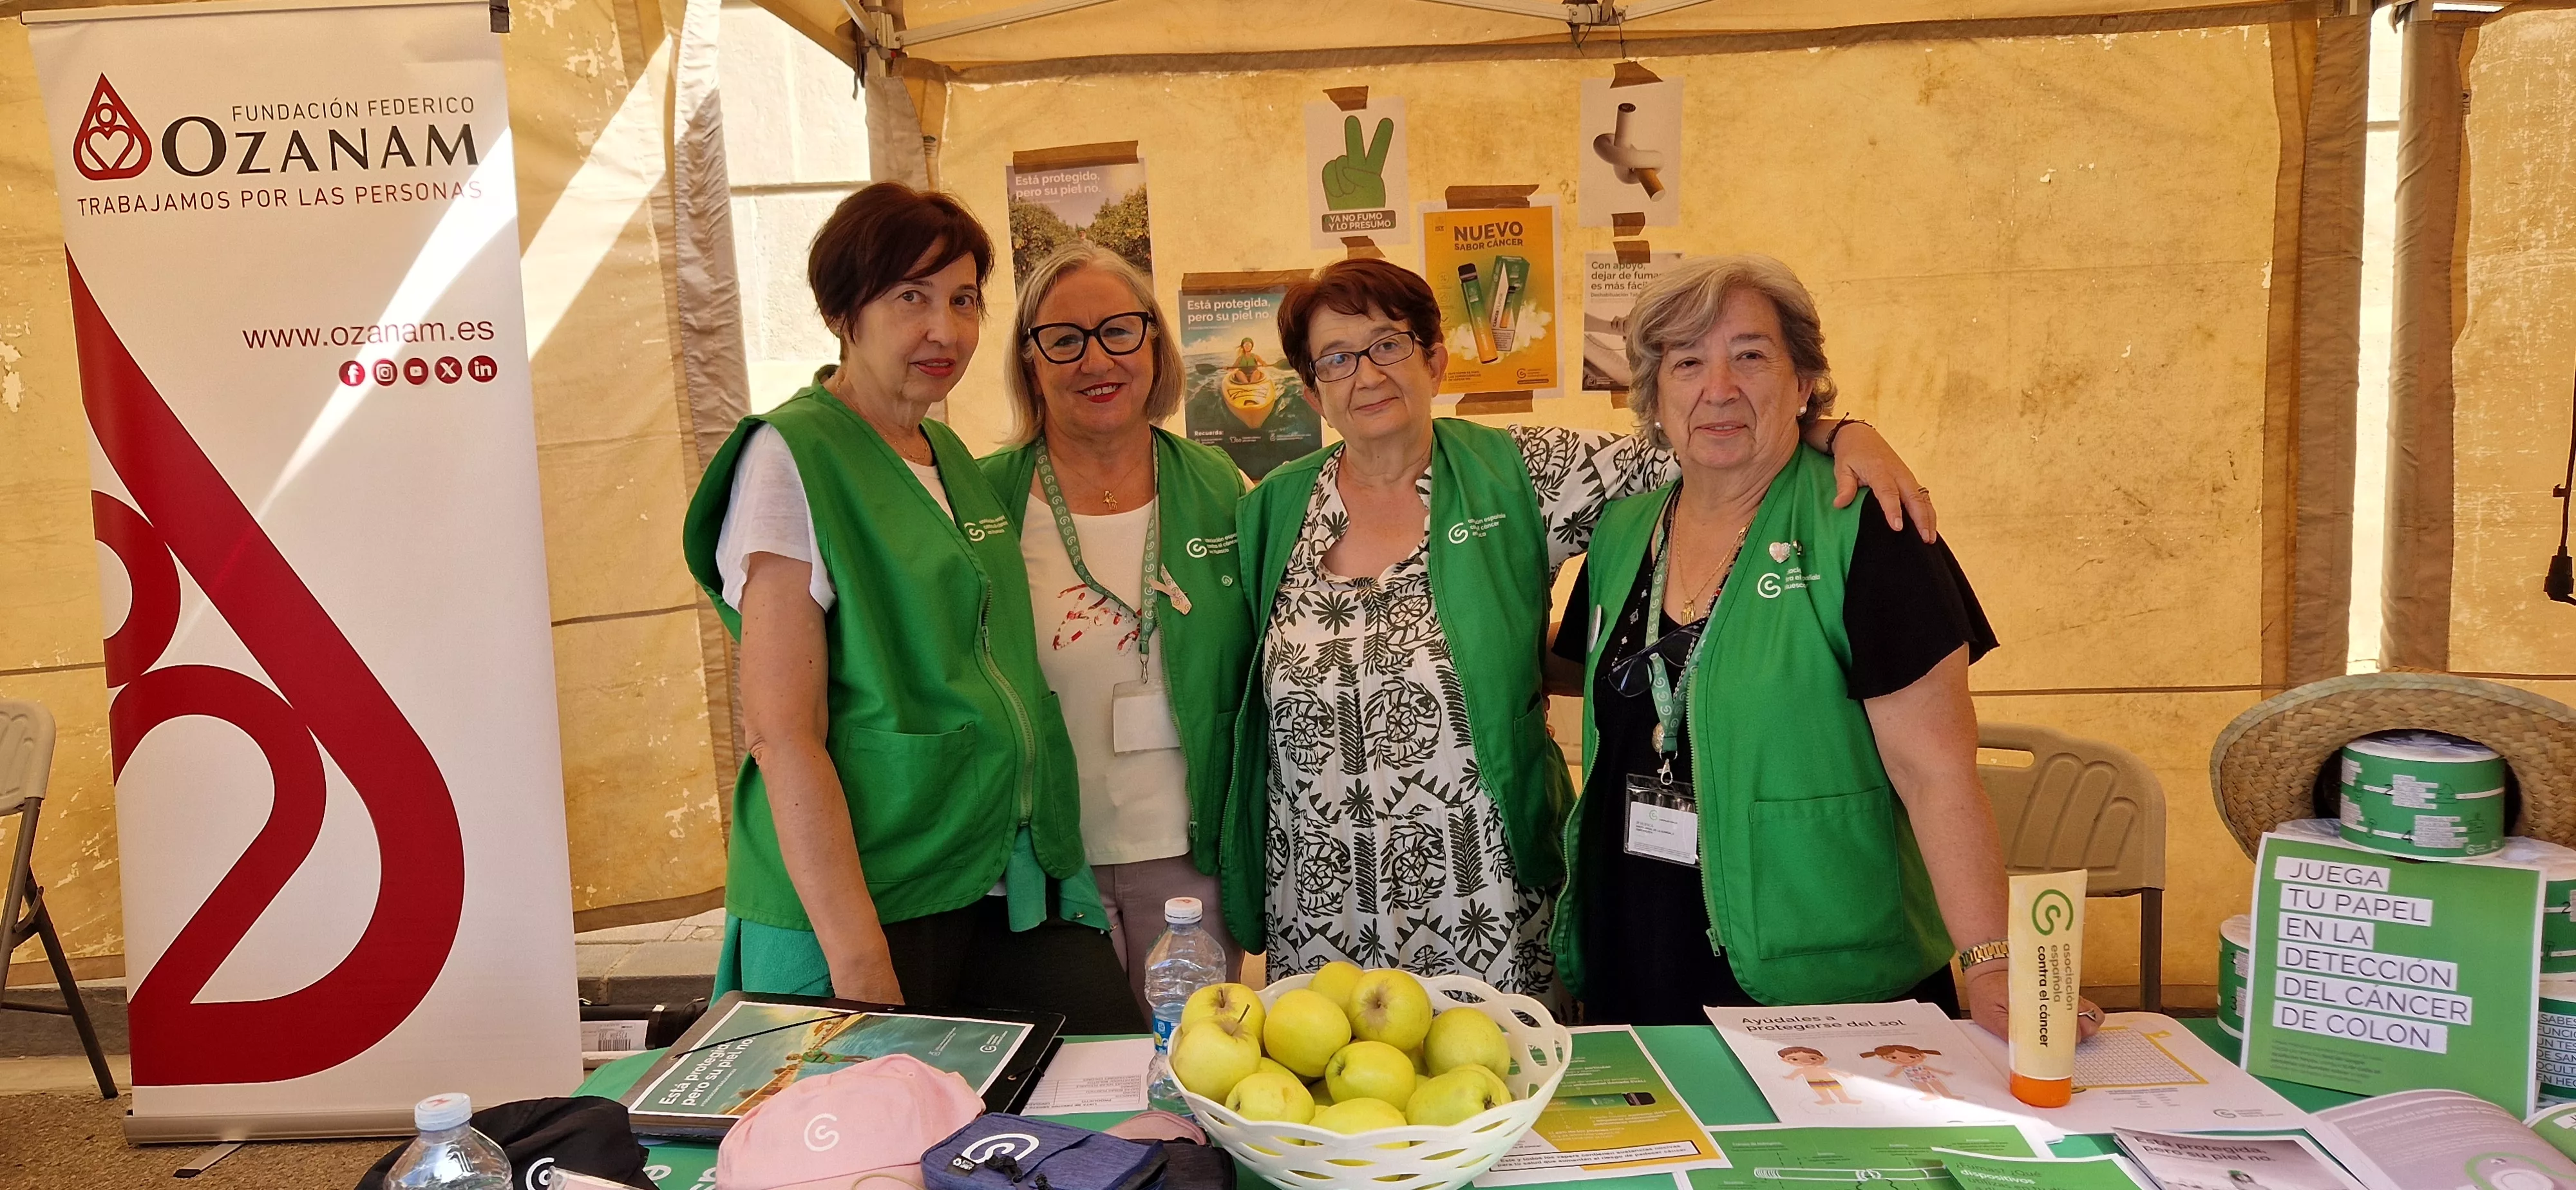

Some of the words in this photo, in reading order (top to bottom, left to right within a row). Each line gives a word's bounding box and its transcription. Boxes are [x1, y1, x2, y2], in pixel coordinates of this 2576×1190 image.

[232, 97, 359, 122] FUNDACIÓN
[368, 96, 475, 117] FEDERICO
[162, 116, 479, 177] OZANAM
[1016, 175, 1039, 185] Está
[78, 191, 231, 216] TRABAJAMOS
[241, 190, 287, 208] POR
[299, 187, 345, 206] LAS
[355, 181, 482, 205] PERSONAS
[1016, 188, 1042, 200] pero
[1045, 187, 1058, 196] su
[1061, 184, 1082, 196] piel
[1084, 185, 1101, 193] no.
[1329, 214, 1341, 223] YA
[1343, 214, 1356, 222] NO
[1357, 212, 1383, 221] FUMO
[1328, 223, 1335, 231] Y
[1336, 222, 1348, 231] LO
[1350, 221, 1392, 230] PRESUMO
[1454, 221, 1524, 241] NUEVO
[1454, 242, 1485, 251] SABOR
[1486, 238, 1524, 249] CÁNCER
[1591, 261, 1611, 270] Con
[1613, 262, 1646, 271] apoyo,
[1591, 271, 1616, 281] dejar
[1618, 271, 1631, 279] de
[1604, 281, 1625, 290] más
[1188, 299, 1211, 310] Está
[1188, 312, 1214, 325] pero
[1216, 312, 1229, 321] su
[1232, 310, 1253, 323] piel
[1255, 310, 1272, 319] no.
[242, 320, 495, 350] www.ozanam.es
[2383, 783, 2394, 796] 2
[2401, 829, 2413, 844] 4
[2289, 862, 2383, 888] JUEGA
[2287, 887, 2325, 909] TU
[2334, 894, 2426, 923] PAPEL
[2562, 901, 2571, 914] 2
[2286, 917, 2323, 940] EN
[2333, 923, 2368, 946] LA
[2037, 945, 2049, 987] contra
[2049, 944, 2062, 1003] española
[2285, 947, 2451, 988] DETECCIÓN
[2063, 943, 2075, 1011] asociación
[2039, 990, 2050, 1001] el
[2230, 996, 2238, 1011] 3
[2283, 976, 2336, 1003] DEL
[2345, 984, 2467, 1022] CÁNCER
[1742, 1015, 1822, 1025] Ayúdales
[1746, 1022, 1842, 1032] protegerse
[2039, 1004, 2050, 1048] cáncer
[2281, 1006, 2317, 1030] DE
[2326, 1014, 2430, 1048] COLON
[681, 1082, 710, 1106] pero
[705, 1068, 724, 1081] su
[719, 1051, 743, 1068] piel
[658, 1082, 691, 1106] Está
[2134, 1136, 2172, 1148] Está
[2142, 1144, 2183, 1156] pero
[2210, 1153, 2246, 1162] piel
[1955, 1162, 2005, 1175] ¿Fumas?
[2011, 1169, 2042, 1178] ¿Qué
[1960, 1169, 2036, 1185] dispositivos
[1967, 1177, 2012, 1189] utilizas
